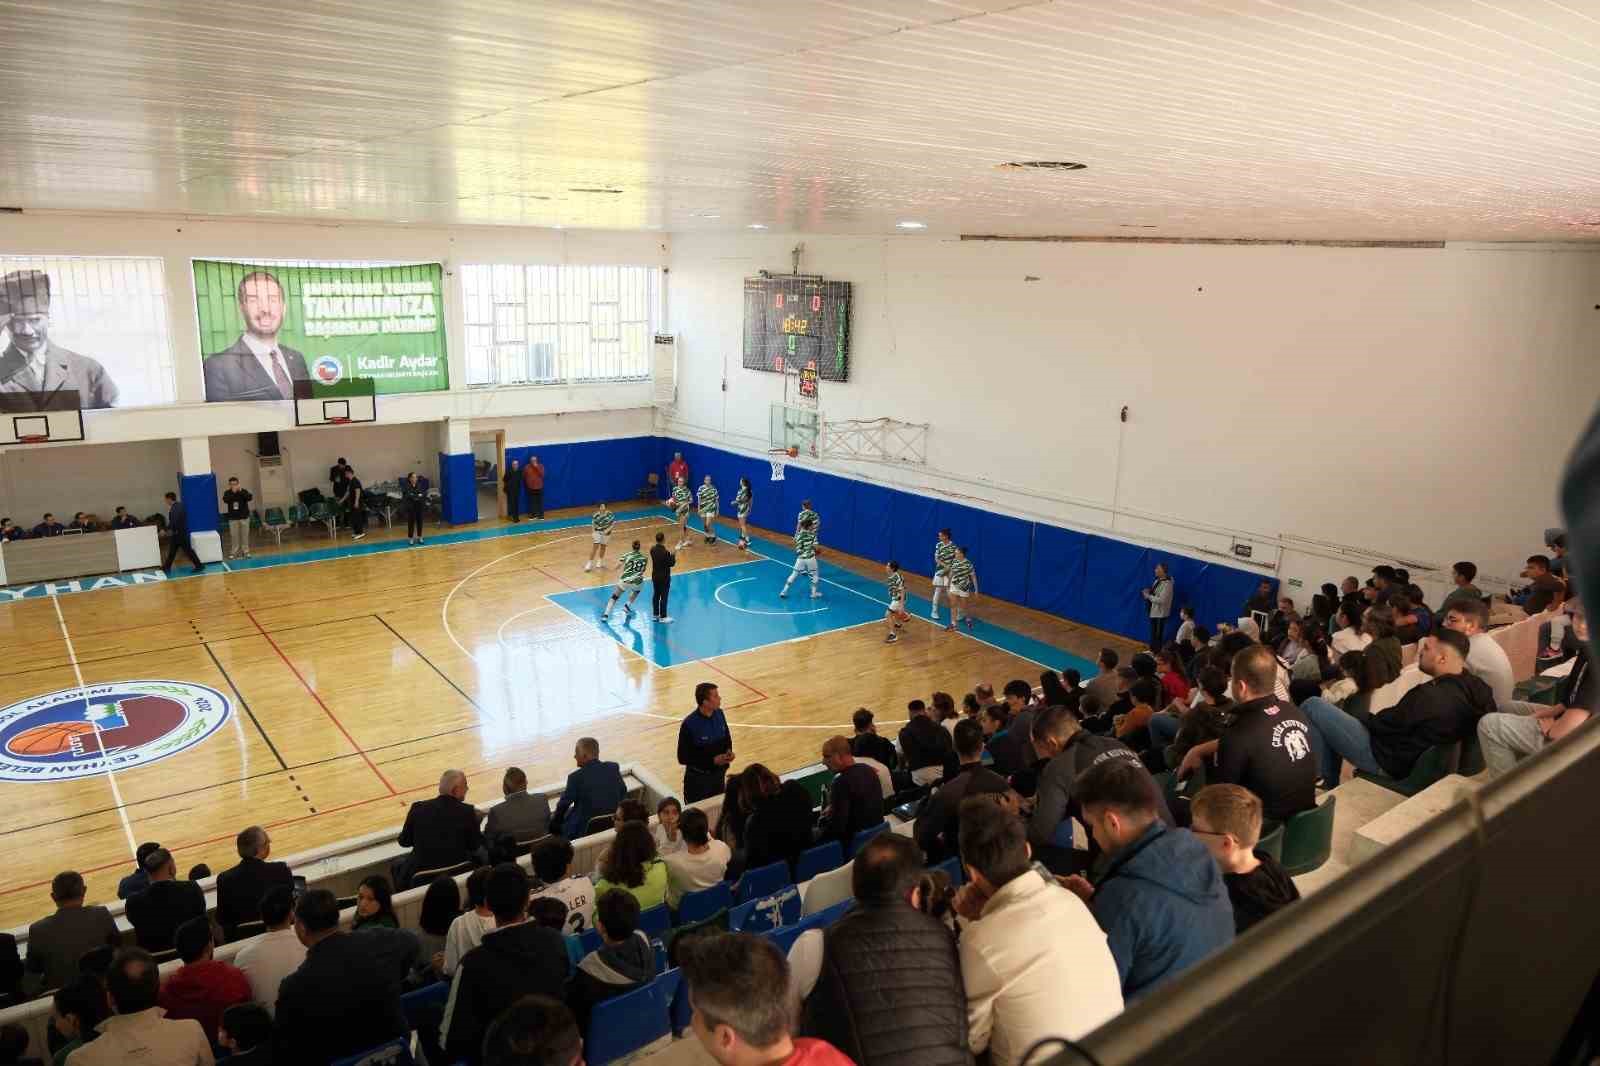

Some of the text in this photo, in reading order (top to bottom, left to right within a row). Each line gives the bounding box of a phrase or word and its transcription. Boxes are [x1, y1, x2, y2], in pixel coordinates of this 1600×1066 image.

[358, 354, 437, 371] Kadir Aydar
[192, 697, 212, 713] 2024
[569, 895, 586, 910] LER
